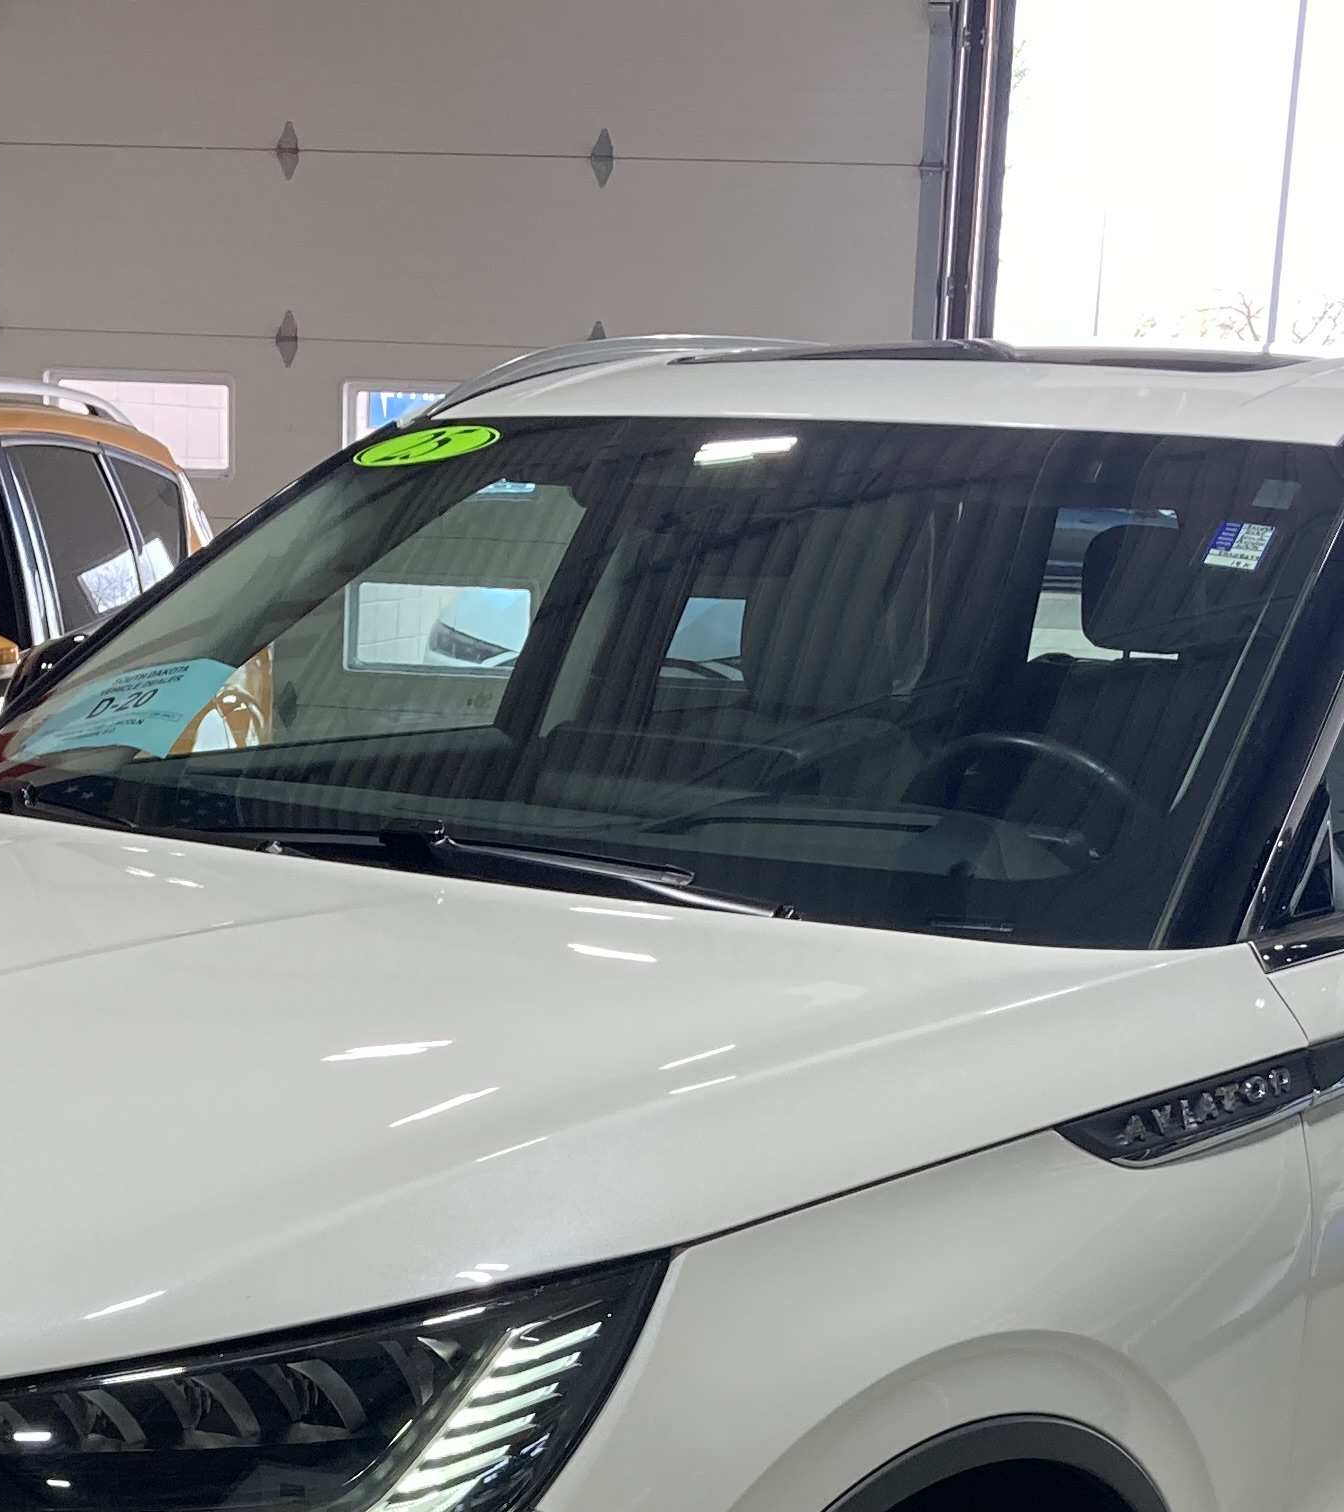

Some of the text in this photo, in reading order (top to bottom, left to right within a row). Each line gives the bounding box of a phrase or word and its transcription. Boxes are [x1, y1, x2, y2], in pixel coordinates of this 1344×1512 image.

[141, 674, 185, 688] DEALER
[146, 664, 190, 678] DAKOTA
[85, 688, 159, 720] D-20
[1115, 1067, 1292, 1146] AVIATOR
